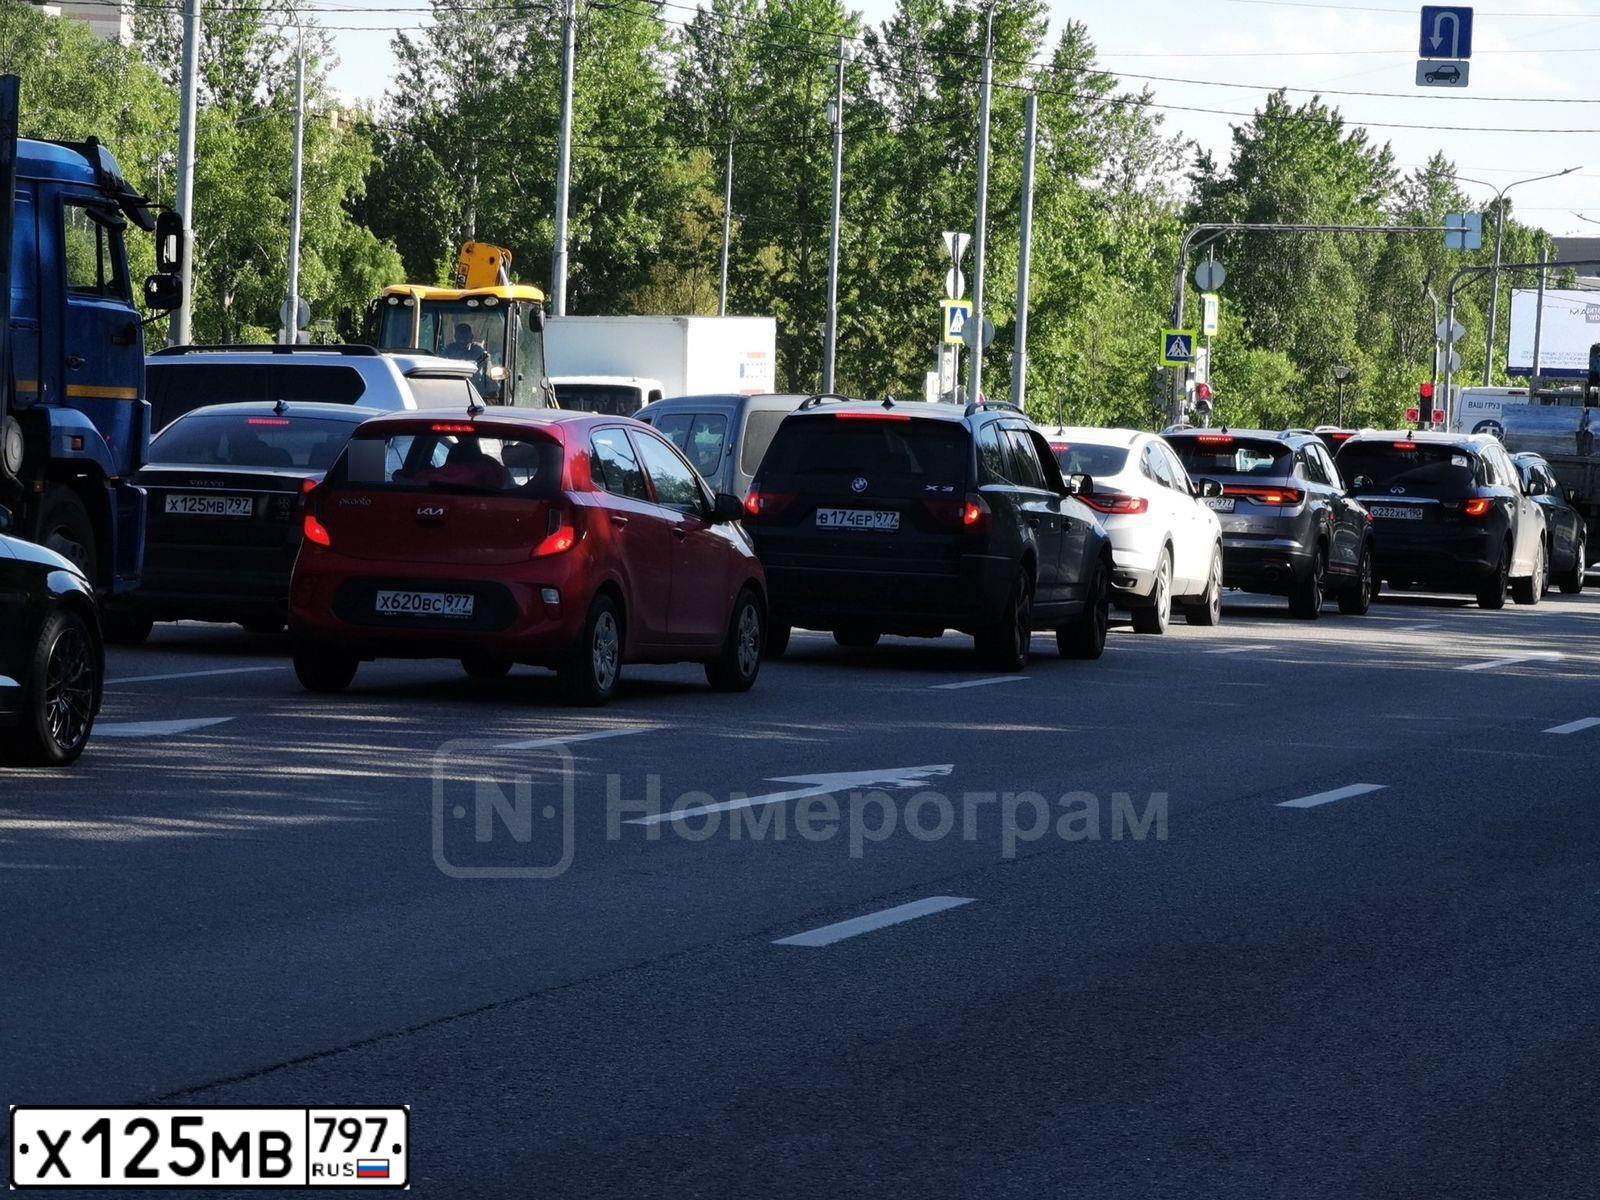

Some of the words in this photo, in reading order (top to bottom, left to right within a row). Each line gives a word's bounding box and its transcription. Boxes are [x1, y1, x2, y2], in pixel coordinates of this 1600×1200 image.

[1467, 401, 1483, 409] ВАШ
[1484, 401, 1500, 410] ГРУЗ
[189, 479, 225, 488] VOLVO
[227, 497, 249, 511] 797
[446, 594, 471, 609] 977
